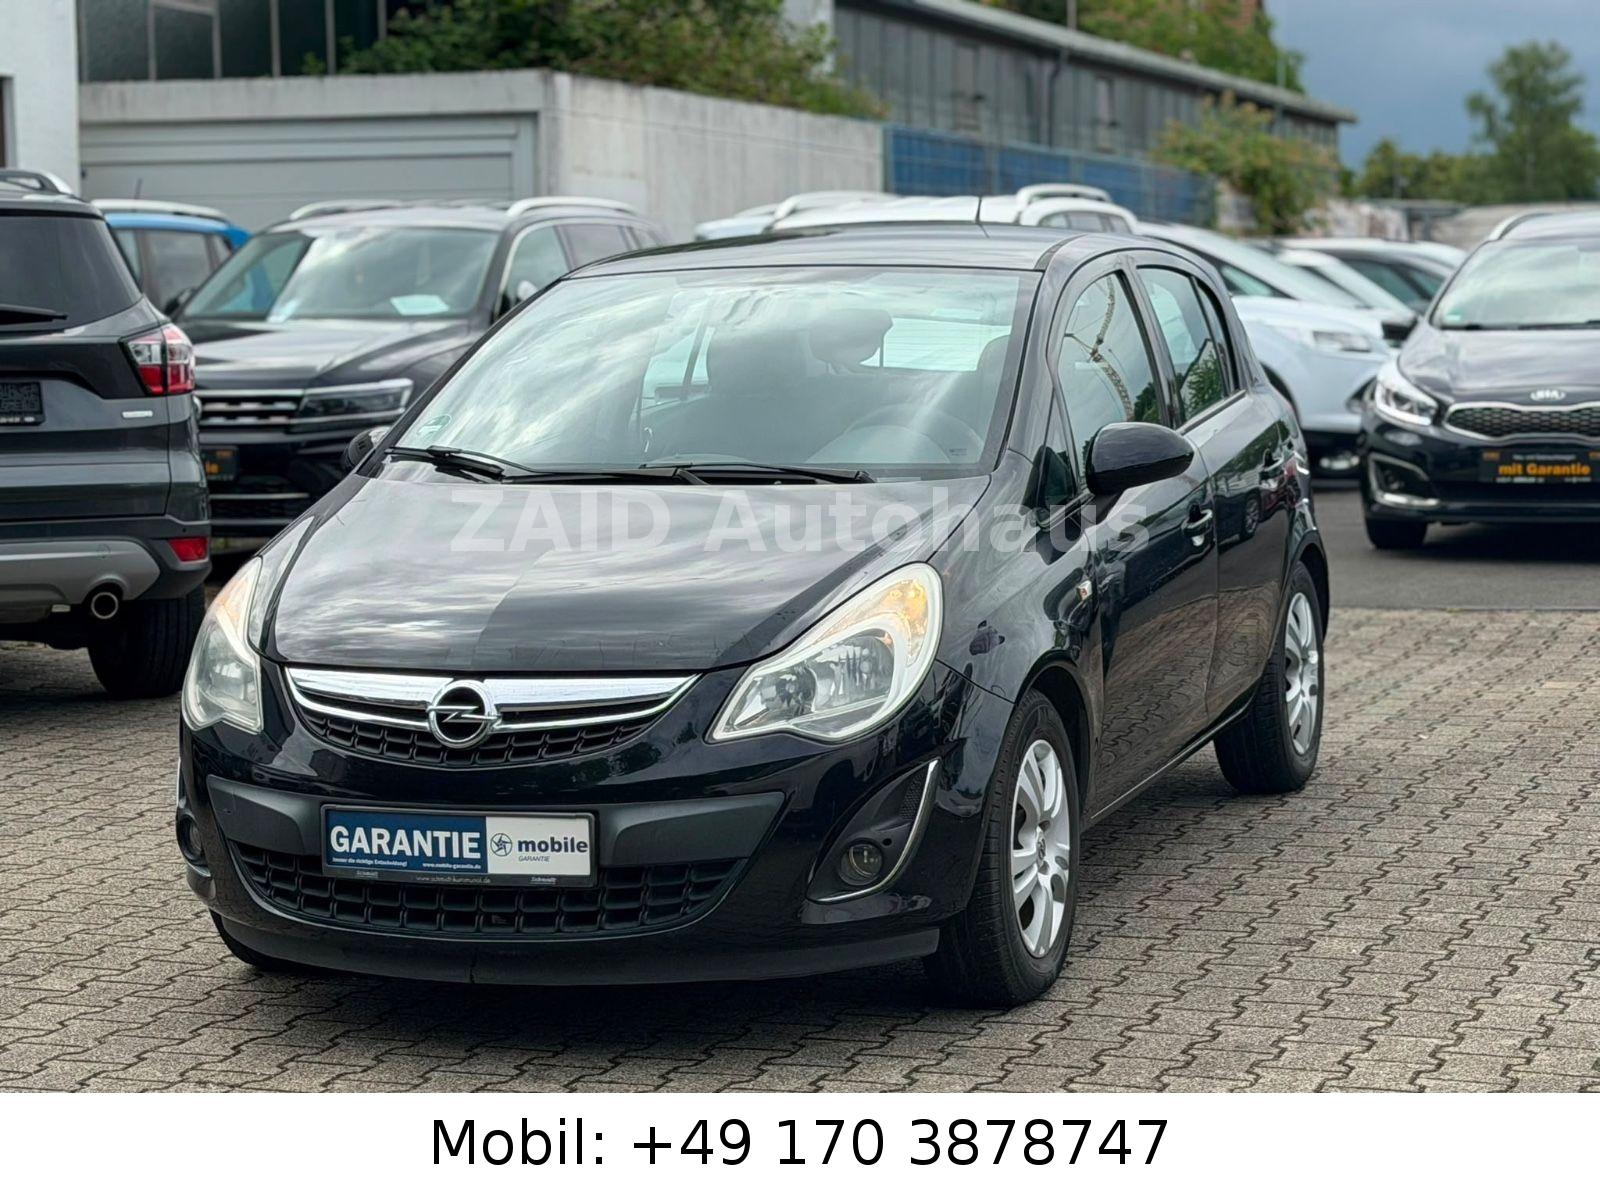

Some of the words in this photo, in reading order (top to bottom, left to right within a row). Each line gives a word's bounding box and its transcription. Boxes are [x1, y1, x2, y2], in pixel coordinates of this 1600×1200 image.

[1499, 462, 1522, 475] mit
[1526, 462, 1591, 475] Garantie
[330, 825, 481, 859] GARANTIE
[517, 836, 588, 853] mobile
[518, 855, 551, 863] GARANTIE
